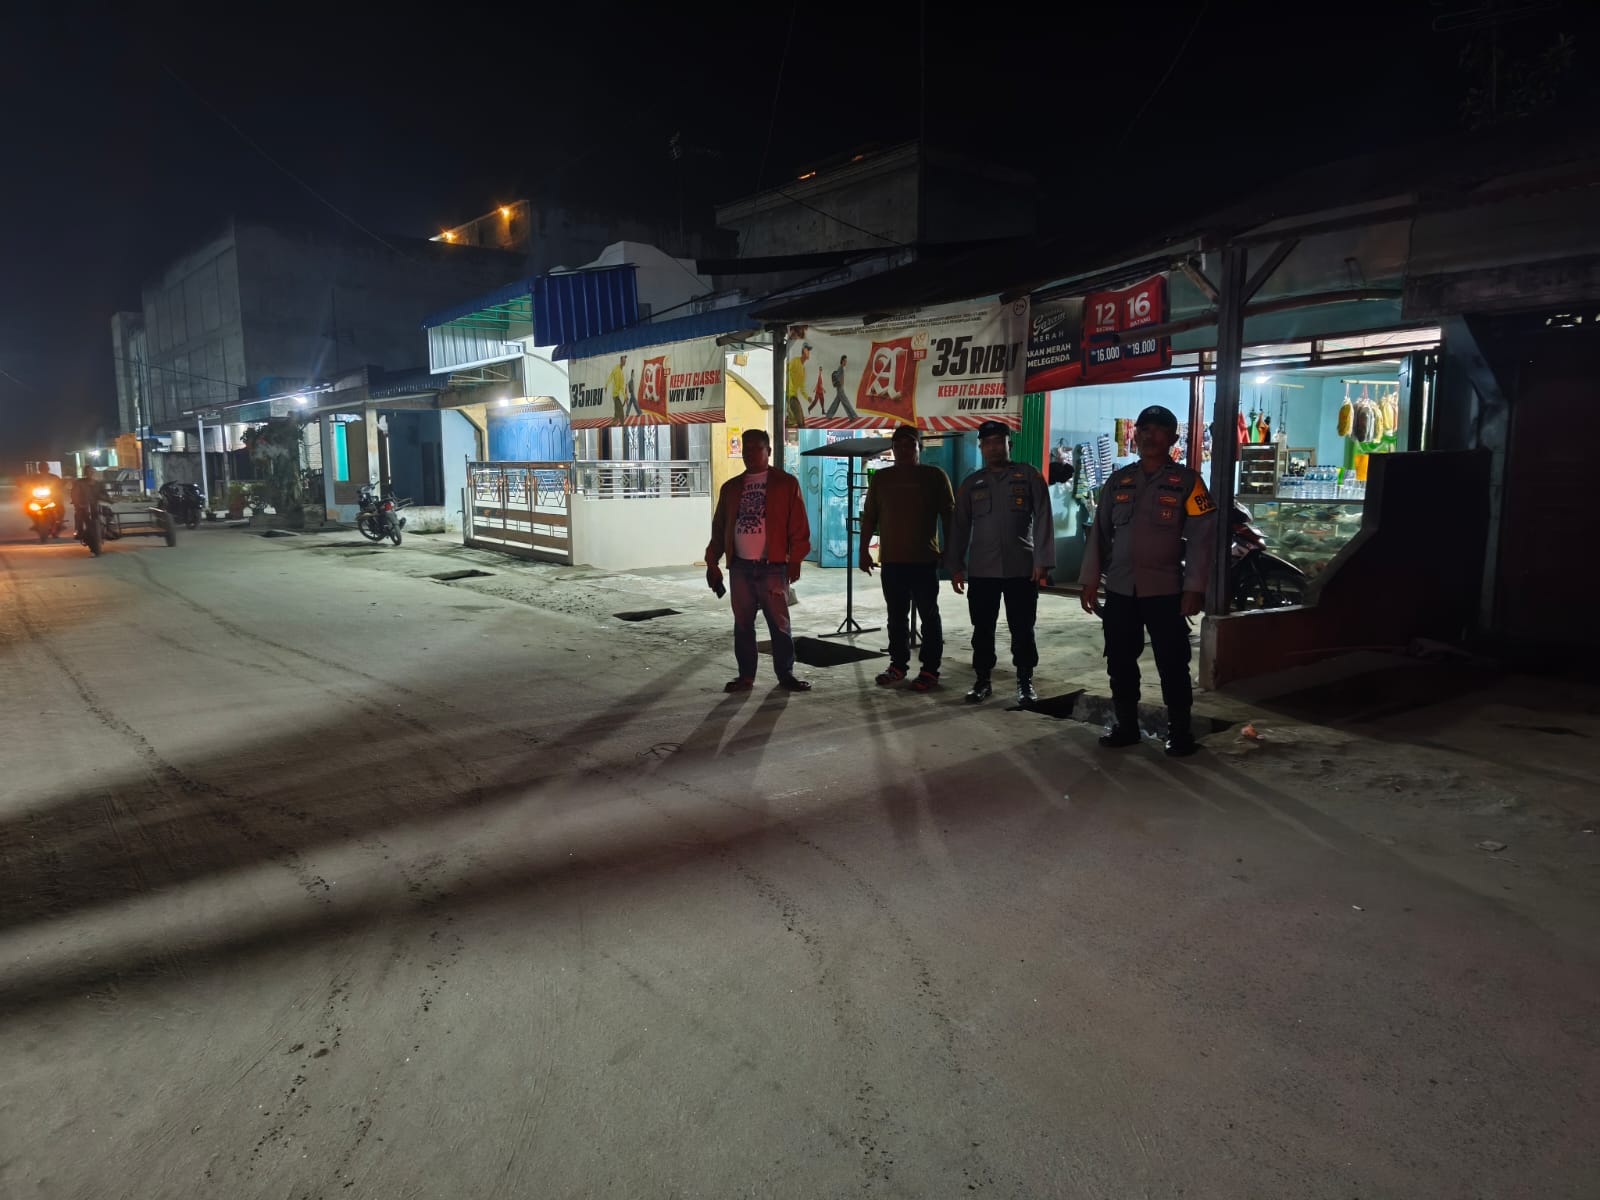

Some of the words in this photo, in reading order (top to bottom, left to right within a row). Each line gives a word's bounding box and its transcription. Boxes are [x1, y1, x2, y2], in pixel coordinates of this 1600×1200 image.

[1127, 292, 1151, 320] 16
[1095, 302, 1116, 326] 12
[1033, 330, 1064, 344] MERAH
[1046, 342, 1072, 354] MERAH
[1096, 346, 1120, 363] 16.000
[1132, 339, 1156, 356] 19.000
[1028, 354, 1070, 368] MELEGENDA
[669, 373, 685, 388] KEEP
[685, 373, 693, 387] IT
[669, 388, 686, 402] WHY
[686, 387, 705, 401] NOT?
[938, 384, 958, 398] KEEP
[959, 384, 969, 397] IT
[958, 398, 981, 410] WHY
[981, 397, 1007, 409] NOT?
